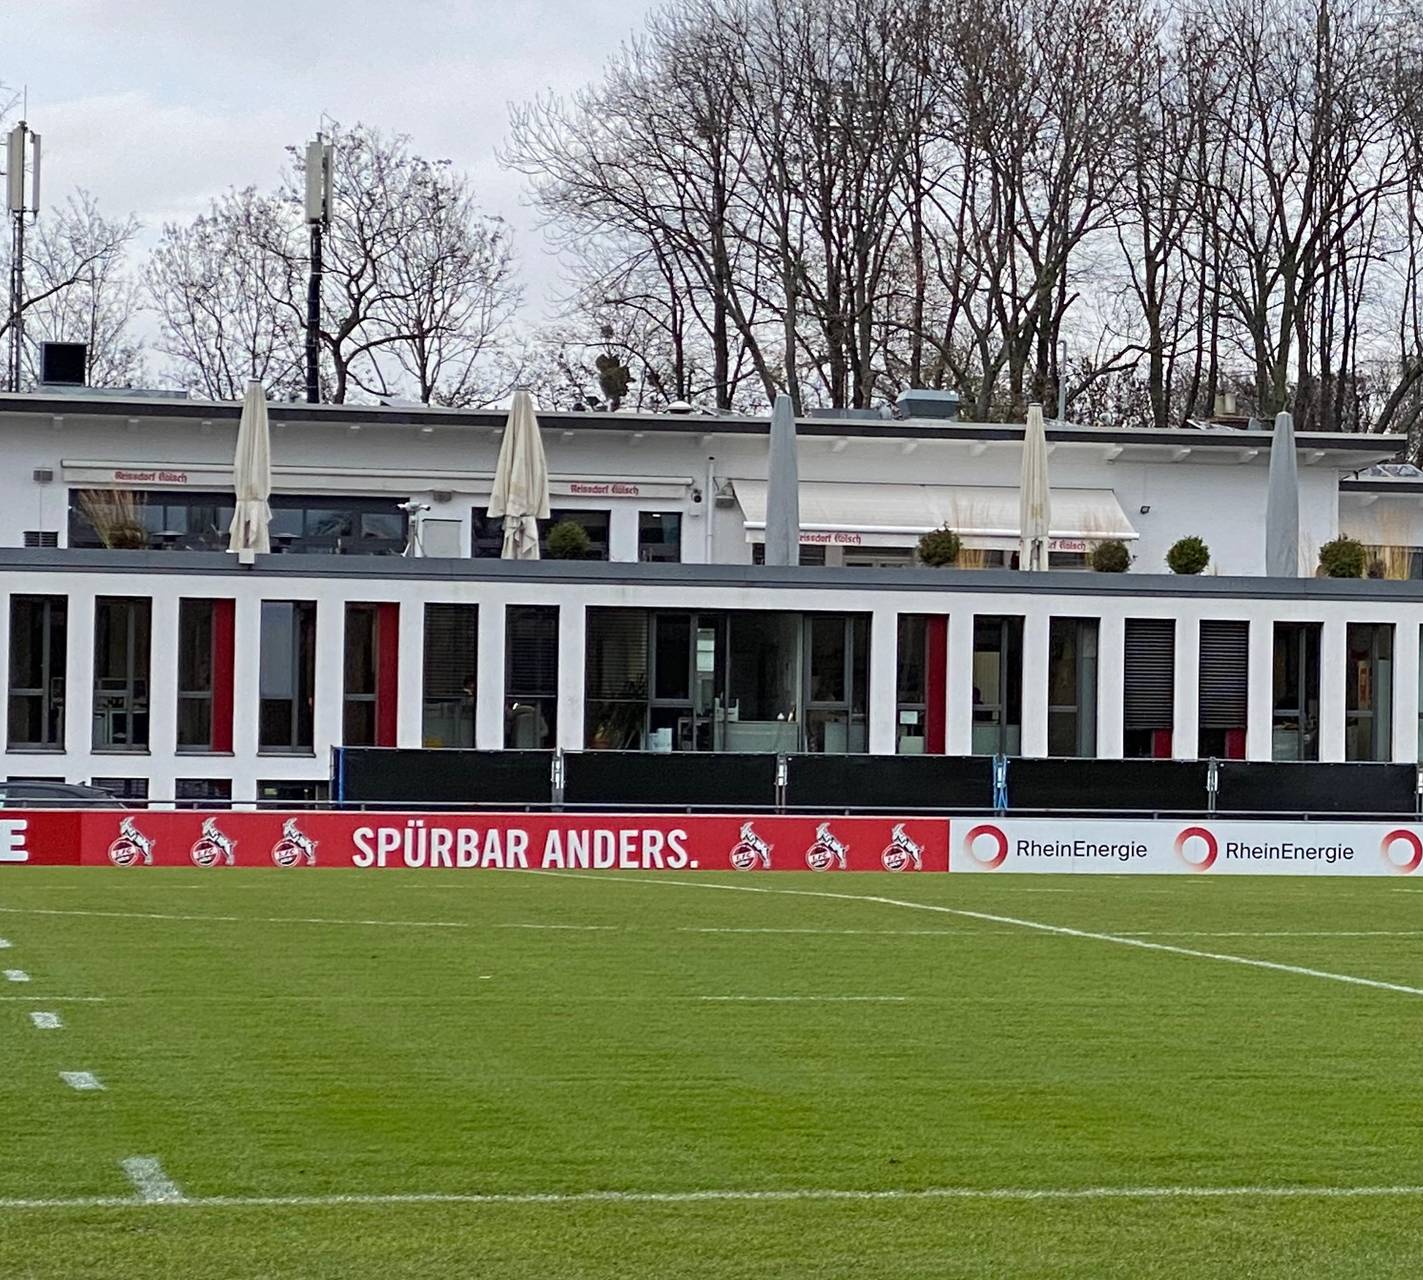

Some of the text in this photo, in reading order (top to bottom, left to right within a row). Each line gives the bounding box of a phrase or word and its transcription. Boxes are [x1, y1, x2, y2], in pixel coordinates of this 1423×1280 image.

[799, 533, 832, 544] eissdorf
[352, 819, 699, 869] SPÜRBAR ANDERS.
[1016, 840, 1148, 861] RheinEnergie
[1226, 843, 1354, 864] RheinEnergie
